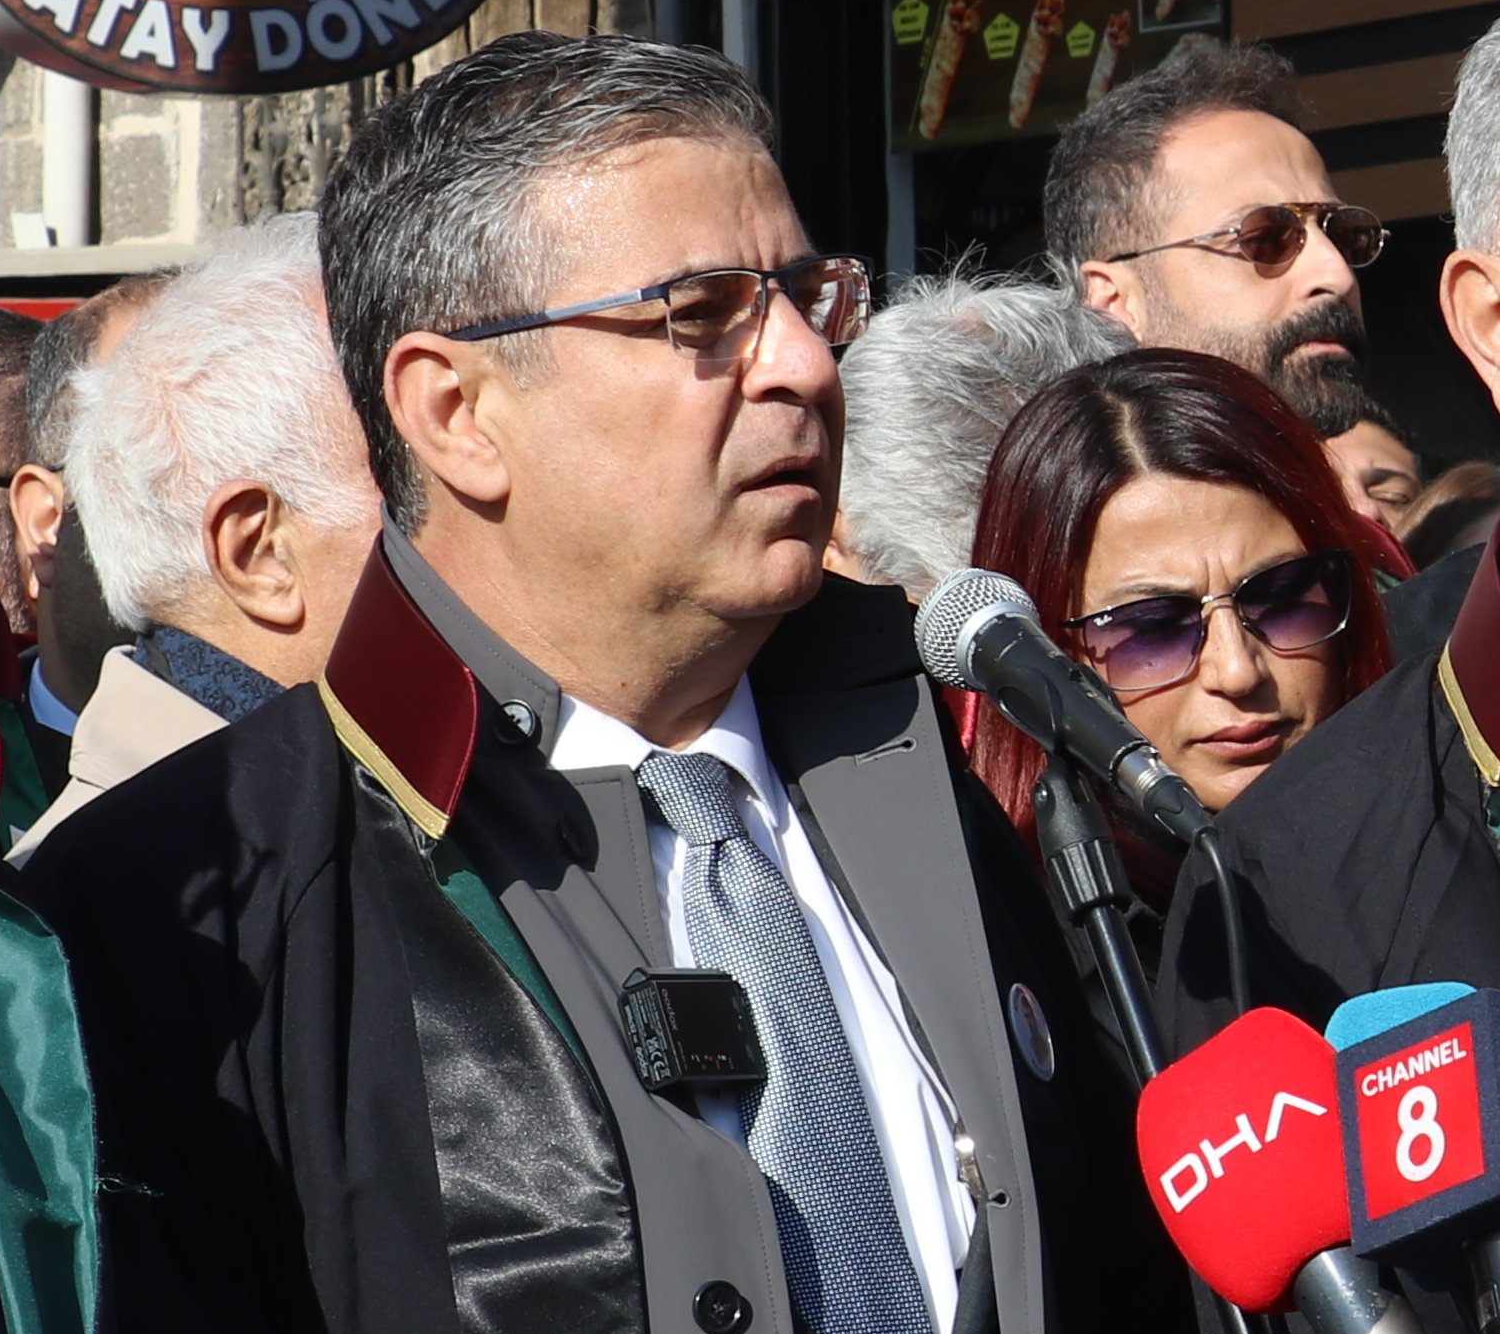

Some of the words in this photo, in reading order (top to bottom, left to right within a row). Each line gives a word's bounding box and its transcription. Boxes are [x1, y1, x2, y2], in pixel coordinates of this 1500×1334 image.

[1361, 1037, 1467, 1098] CHANNEL
[1159, 1091, 1328, 1213] DHA
[1395, 1084, 1446, 1182] 8
